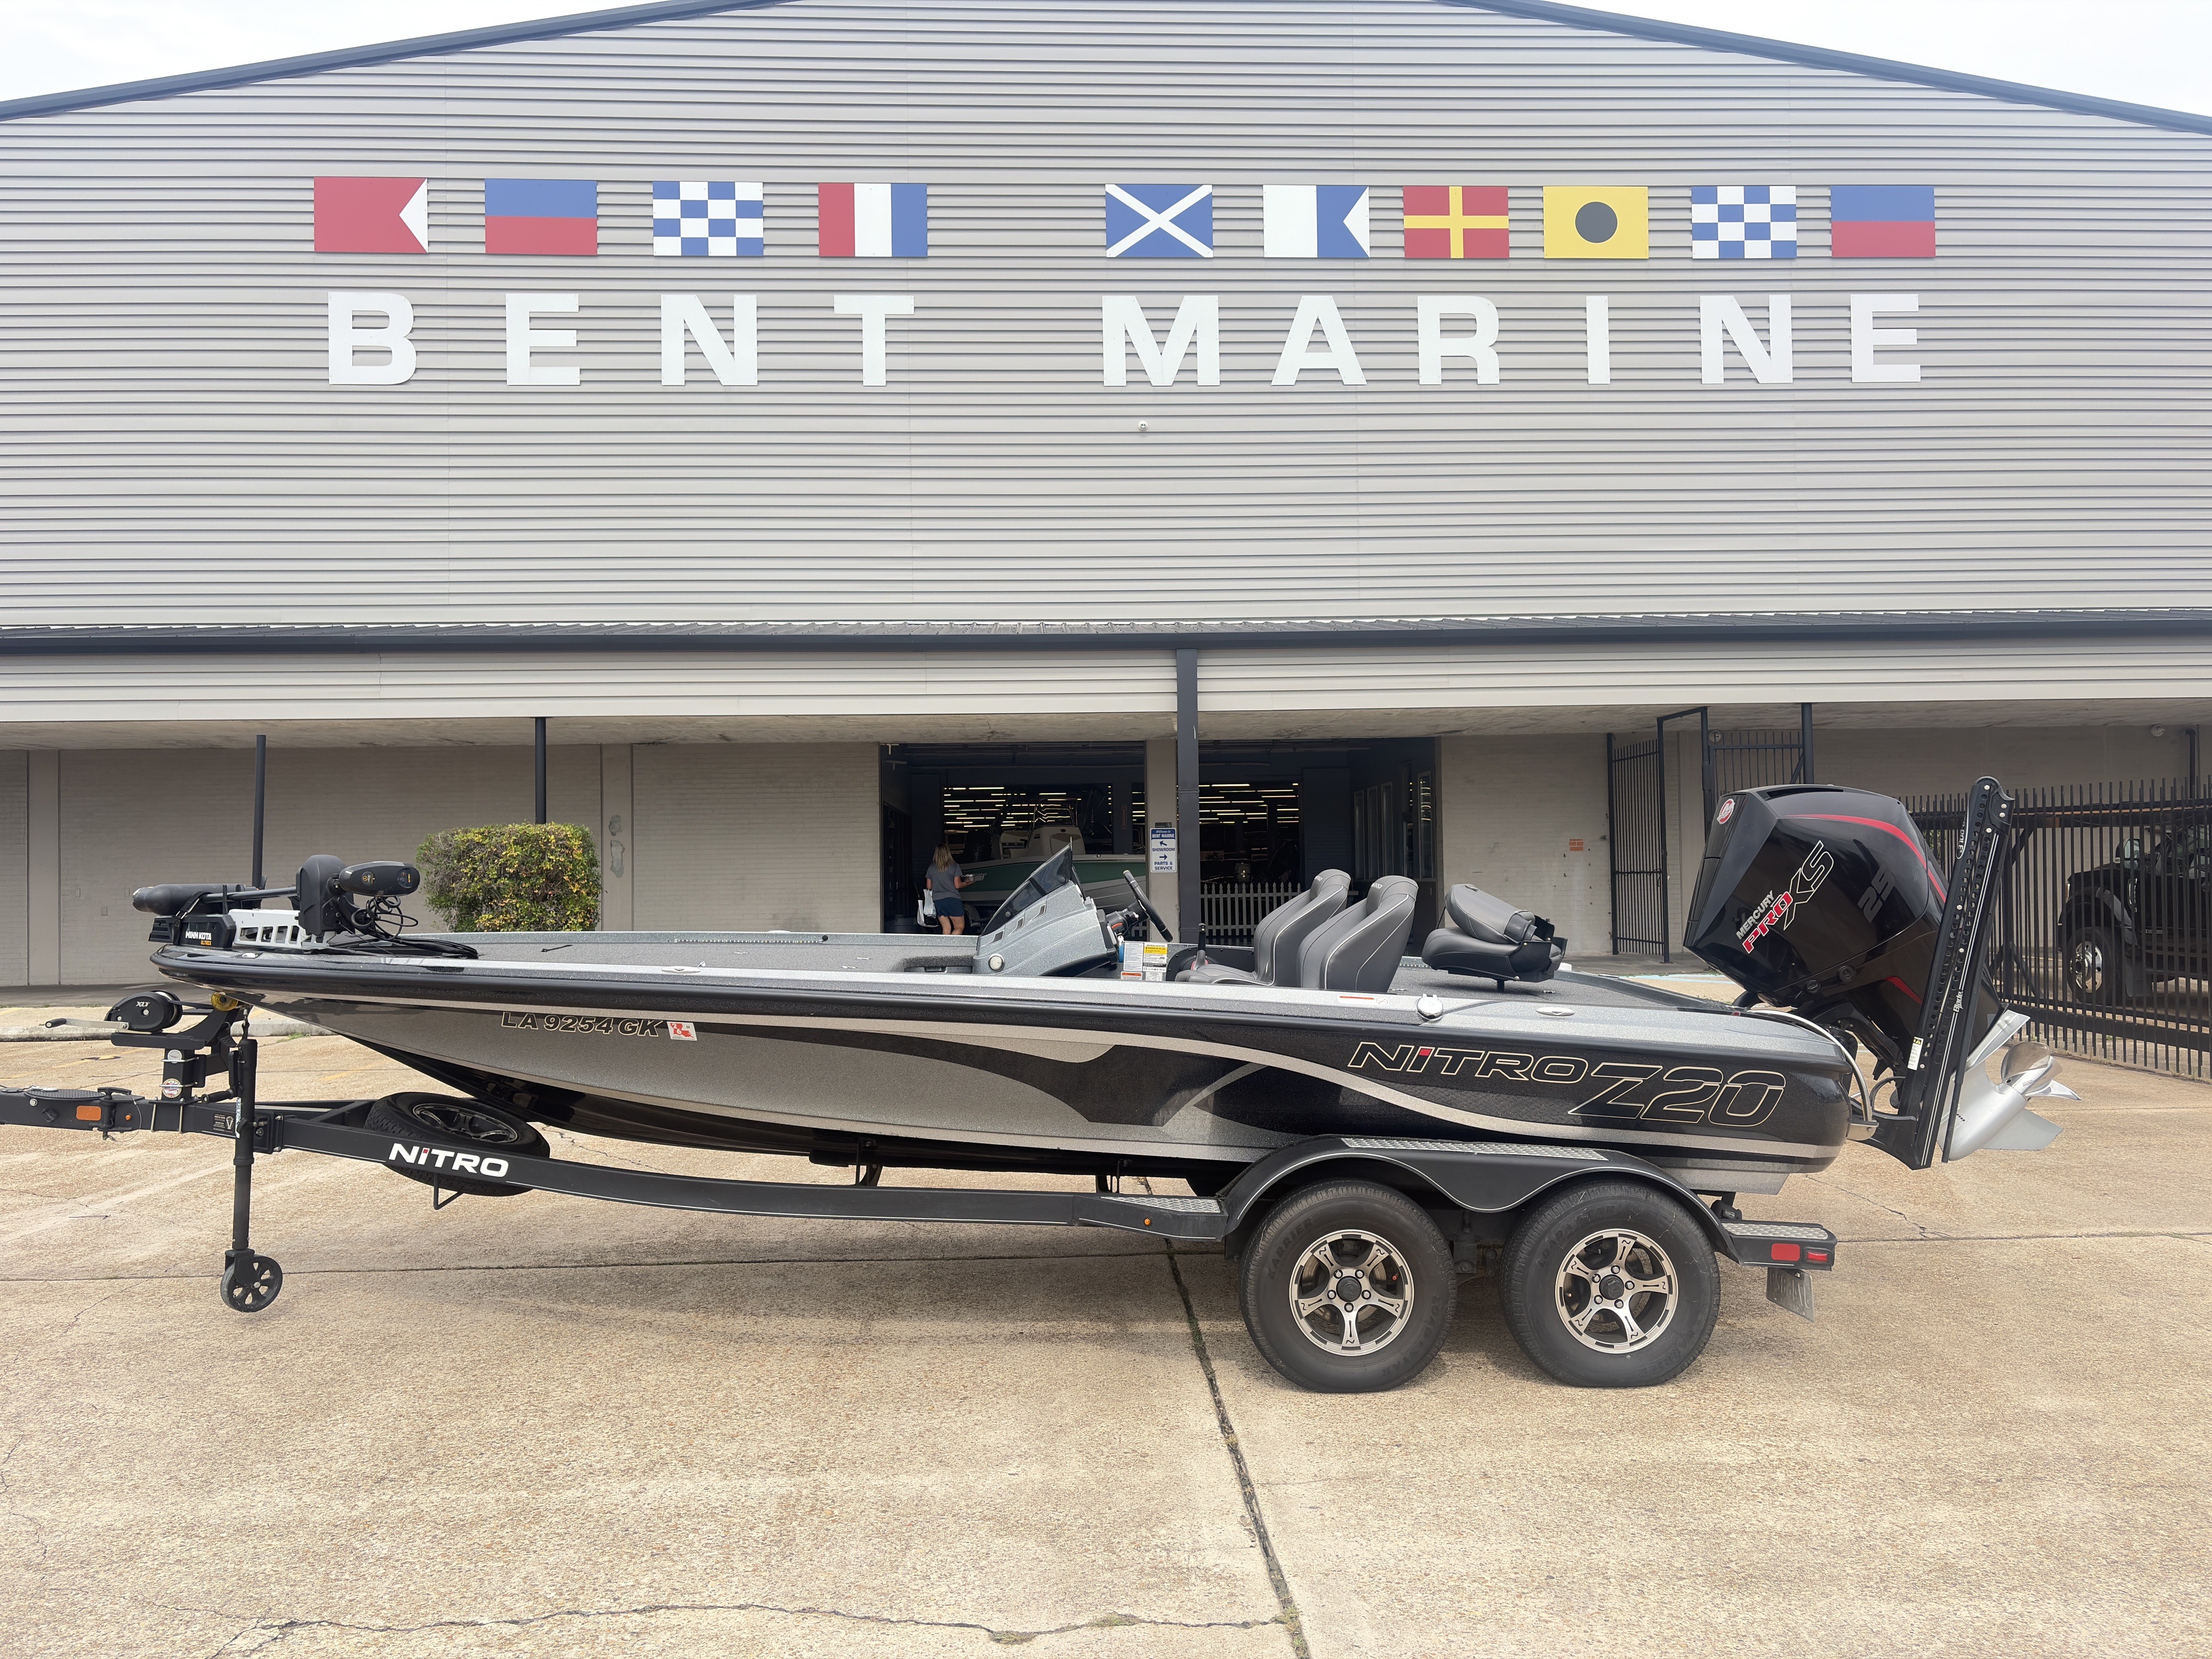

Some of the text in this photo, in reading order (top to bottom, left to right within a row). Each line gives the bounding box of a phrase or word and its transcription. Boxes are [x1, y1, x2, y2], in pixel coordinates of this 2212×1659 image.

[328, 291, 1921, 386] BENT MARINE
[1736, 889, 1775, 940] MERCURY
[1742, 840, 1834, 954] PRO XS
[199, 932, 212, 940] KOTA
[1953, 991, 1963, 1012] Blade
[501, 1012, 664, 1037] LA 9254 GK
[1347, 1041, 1787, 1126] NITRO Z20
[388, 1143, 509, 1177] NITRO
